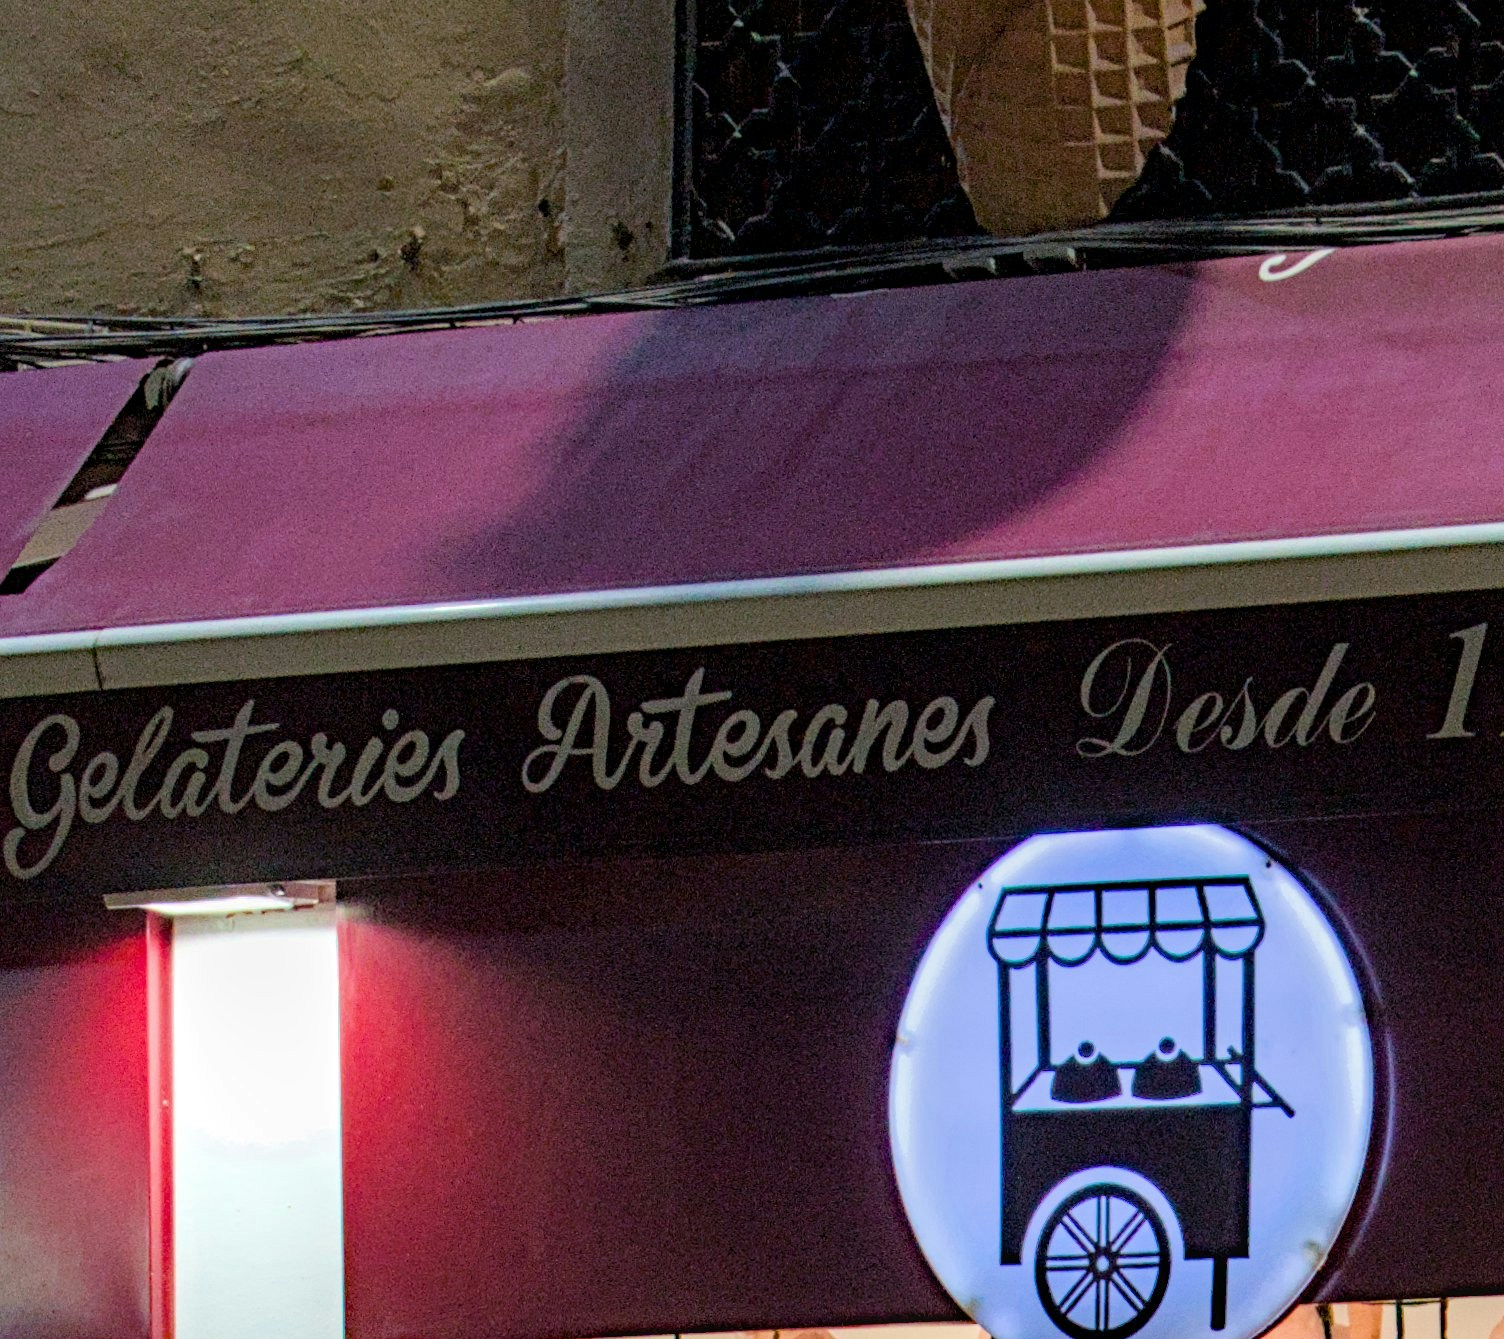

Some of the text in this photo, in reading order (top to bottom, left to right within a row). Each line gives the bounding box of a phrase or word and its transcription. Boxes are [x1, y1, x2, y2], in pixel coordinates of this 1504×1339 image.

[3, 698, 466, 880] Gelateries
[522, 667, 996, 793] Artesanes
[1076, 637, 1377, 758] Desde
